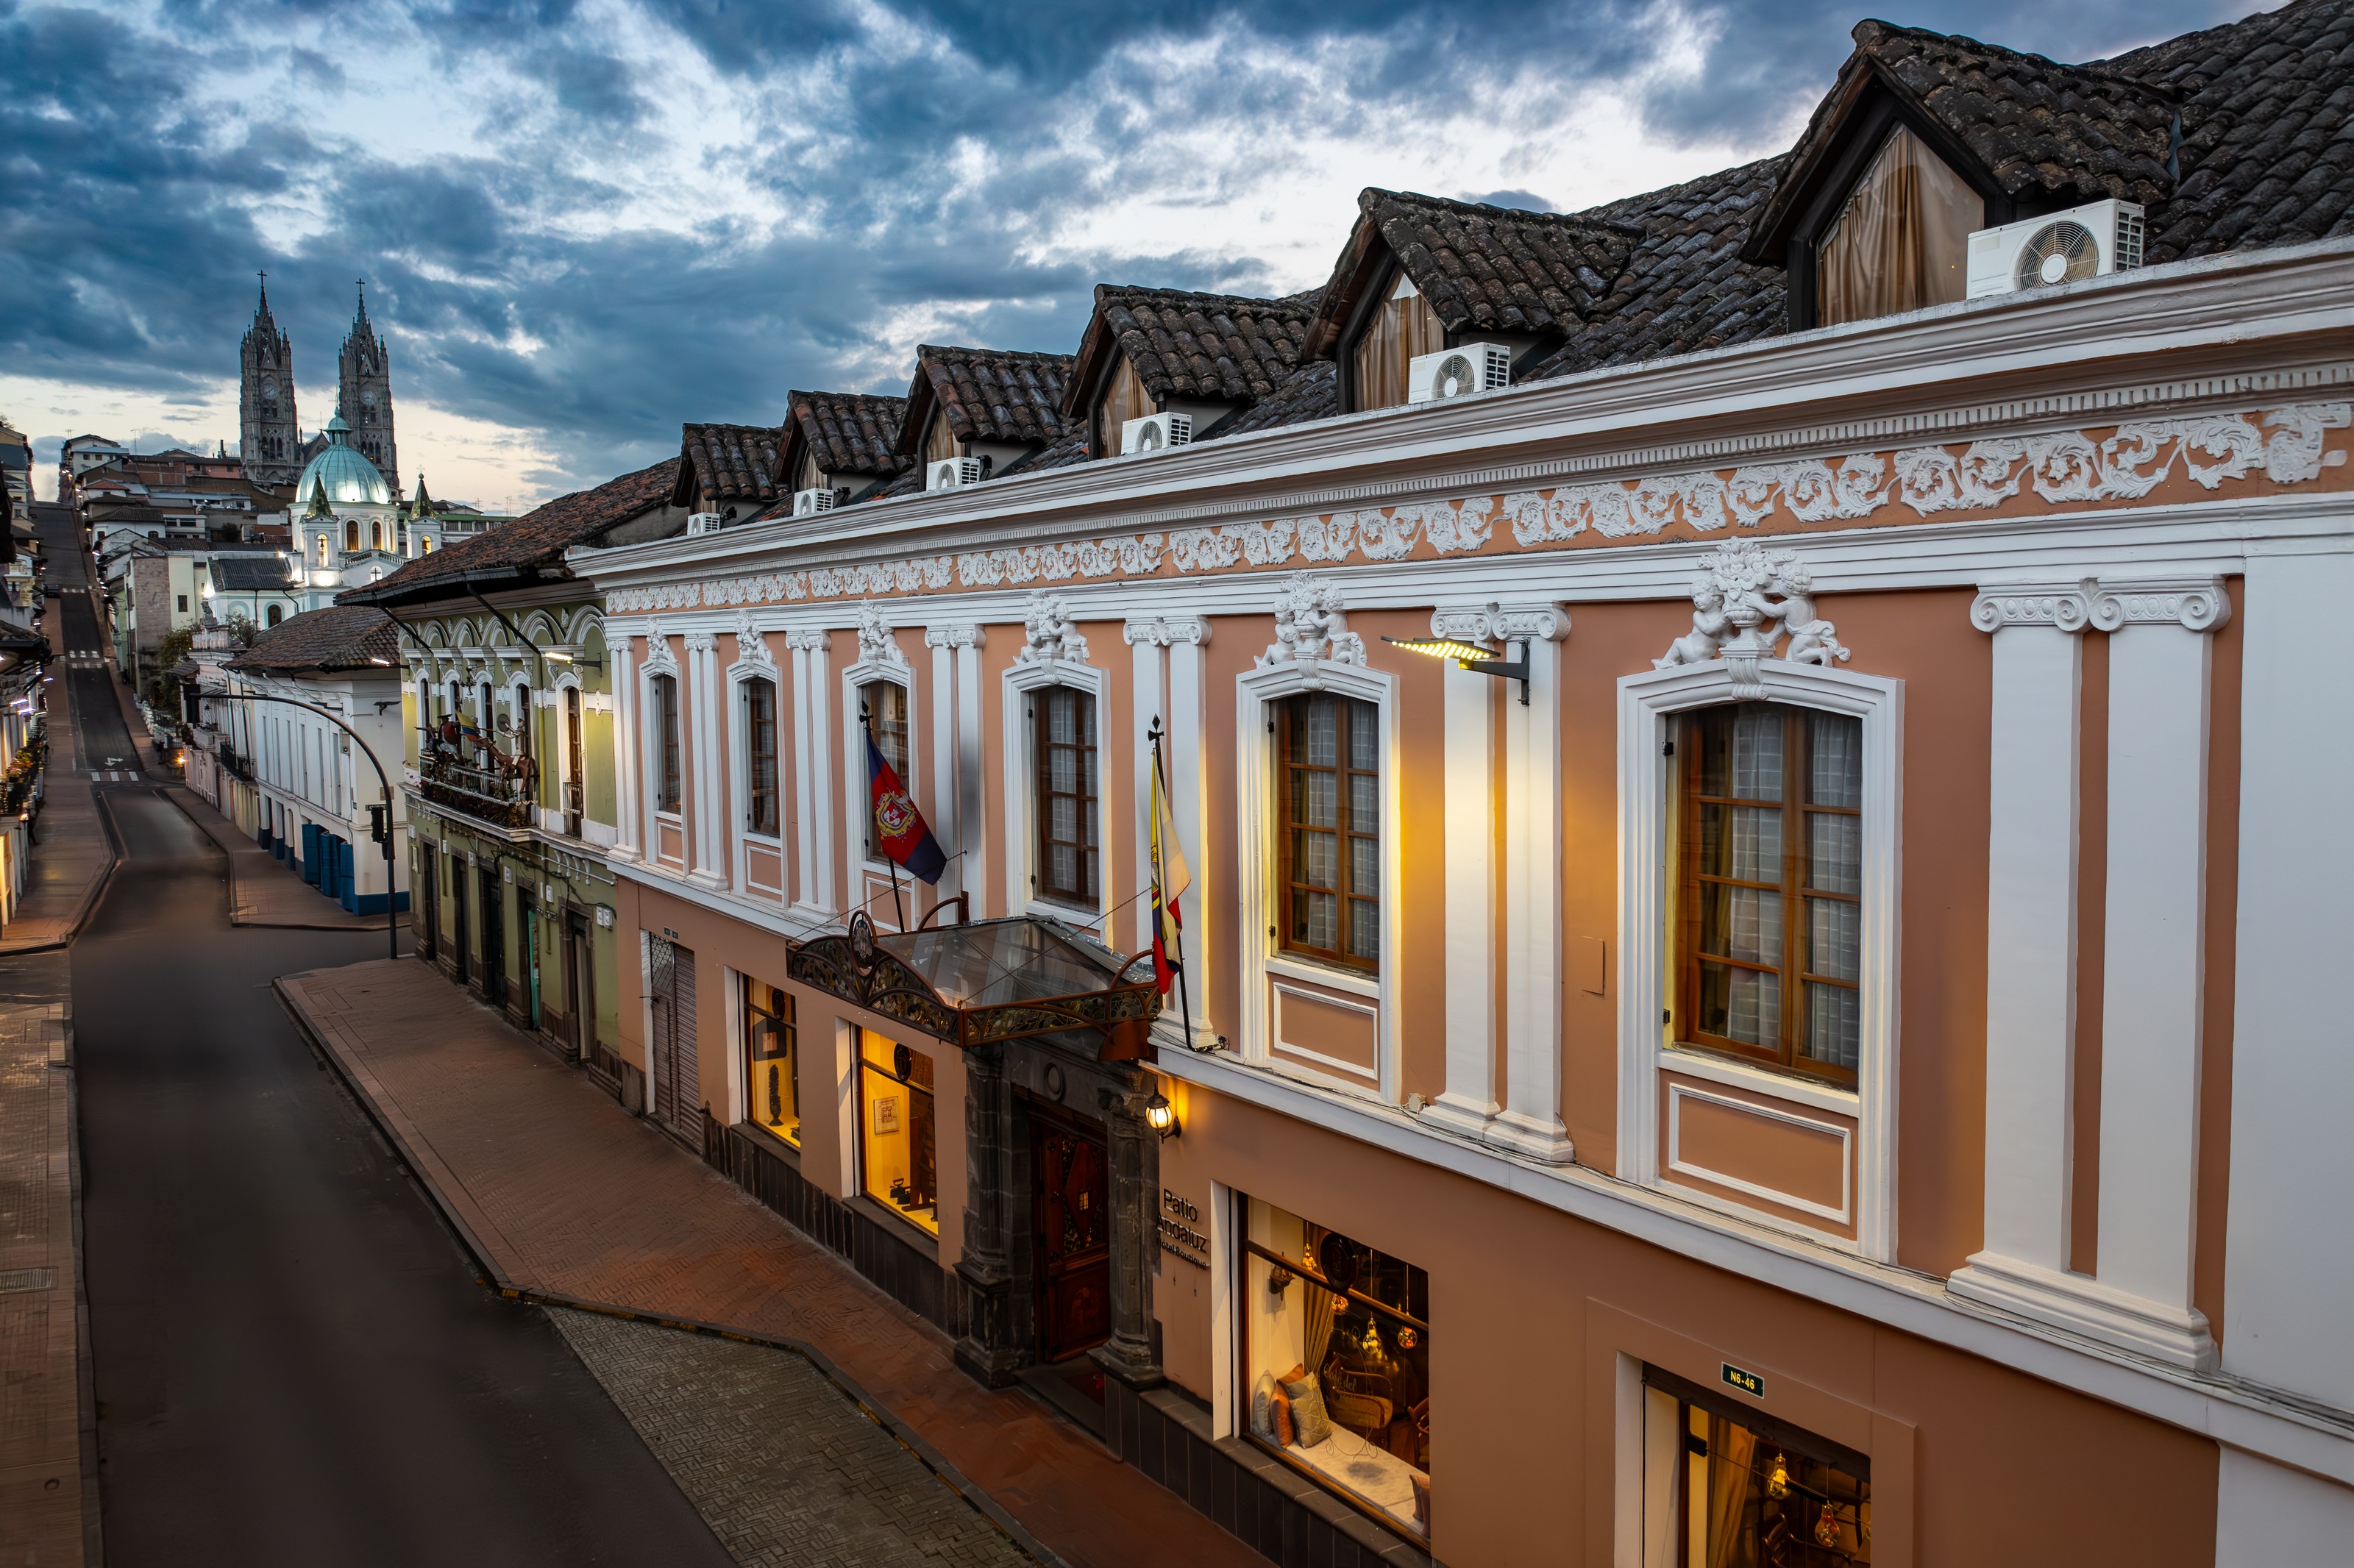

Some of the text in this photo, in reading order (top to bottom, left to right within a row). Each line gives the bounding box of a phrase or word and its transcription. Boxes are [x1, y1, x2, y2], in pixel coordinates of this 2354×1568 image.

[1164, 1189, 1198, 1222] Patio
[1156, 1212, 1207, 1254] Andaluz
[1176, 1246, 1207, 1270] Boutique
[1730, 1370, 1755, 1390] N6-46
